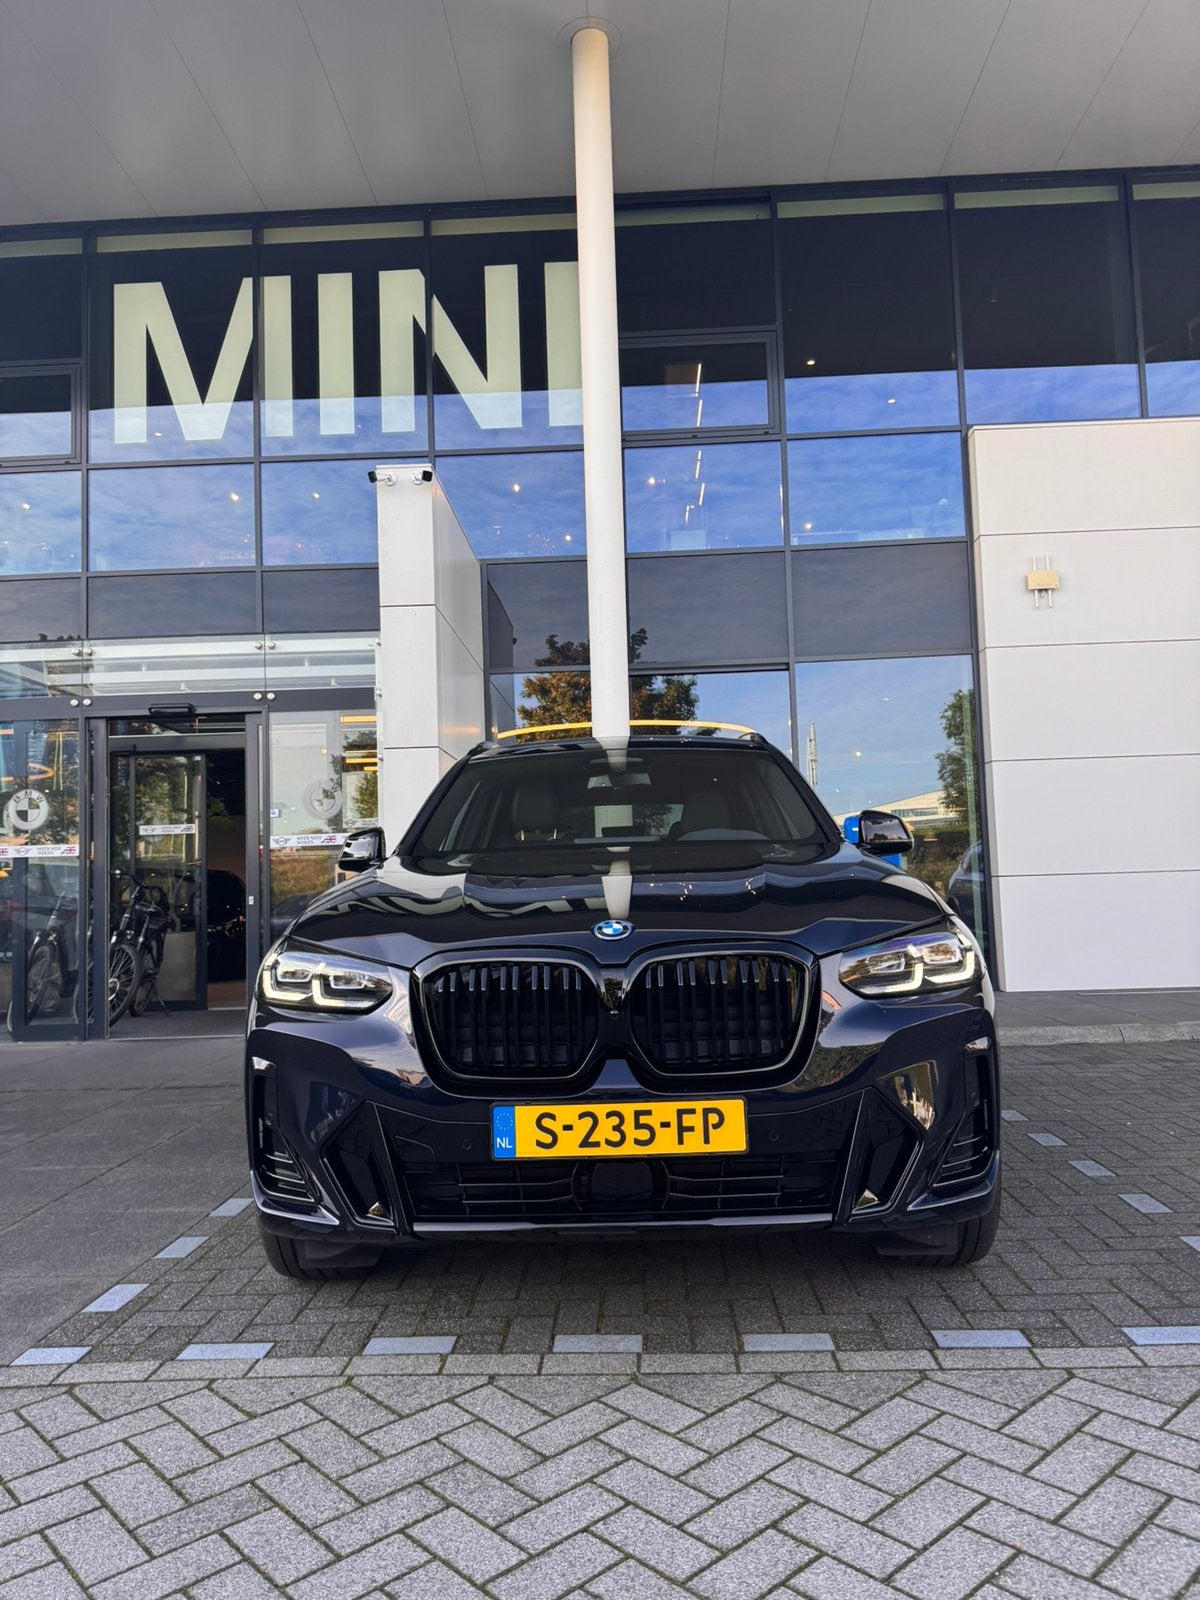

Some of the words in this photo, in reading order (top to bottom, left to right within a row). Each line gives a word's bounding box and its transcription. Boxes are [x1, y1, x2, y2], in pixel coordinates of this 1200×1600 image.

[113, 261, 584, 444] MINI
[13, 790, 45, 803] BMW
[535, 1107, 725, 1150] S-235-FP
[496, 1137, 513, 1149] NL
